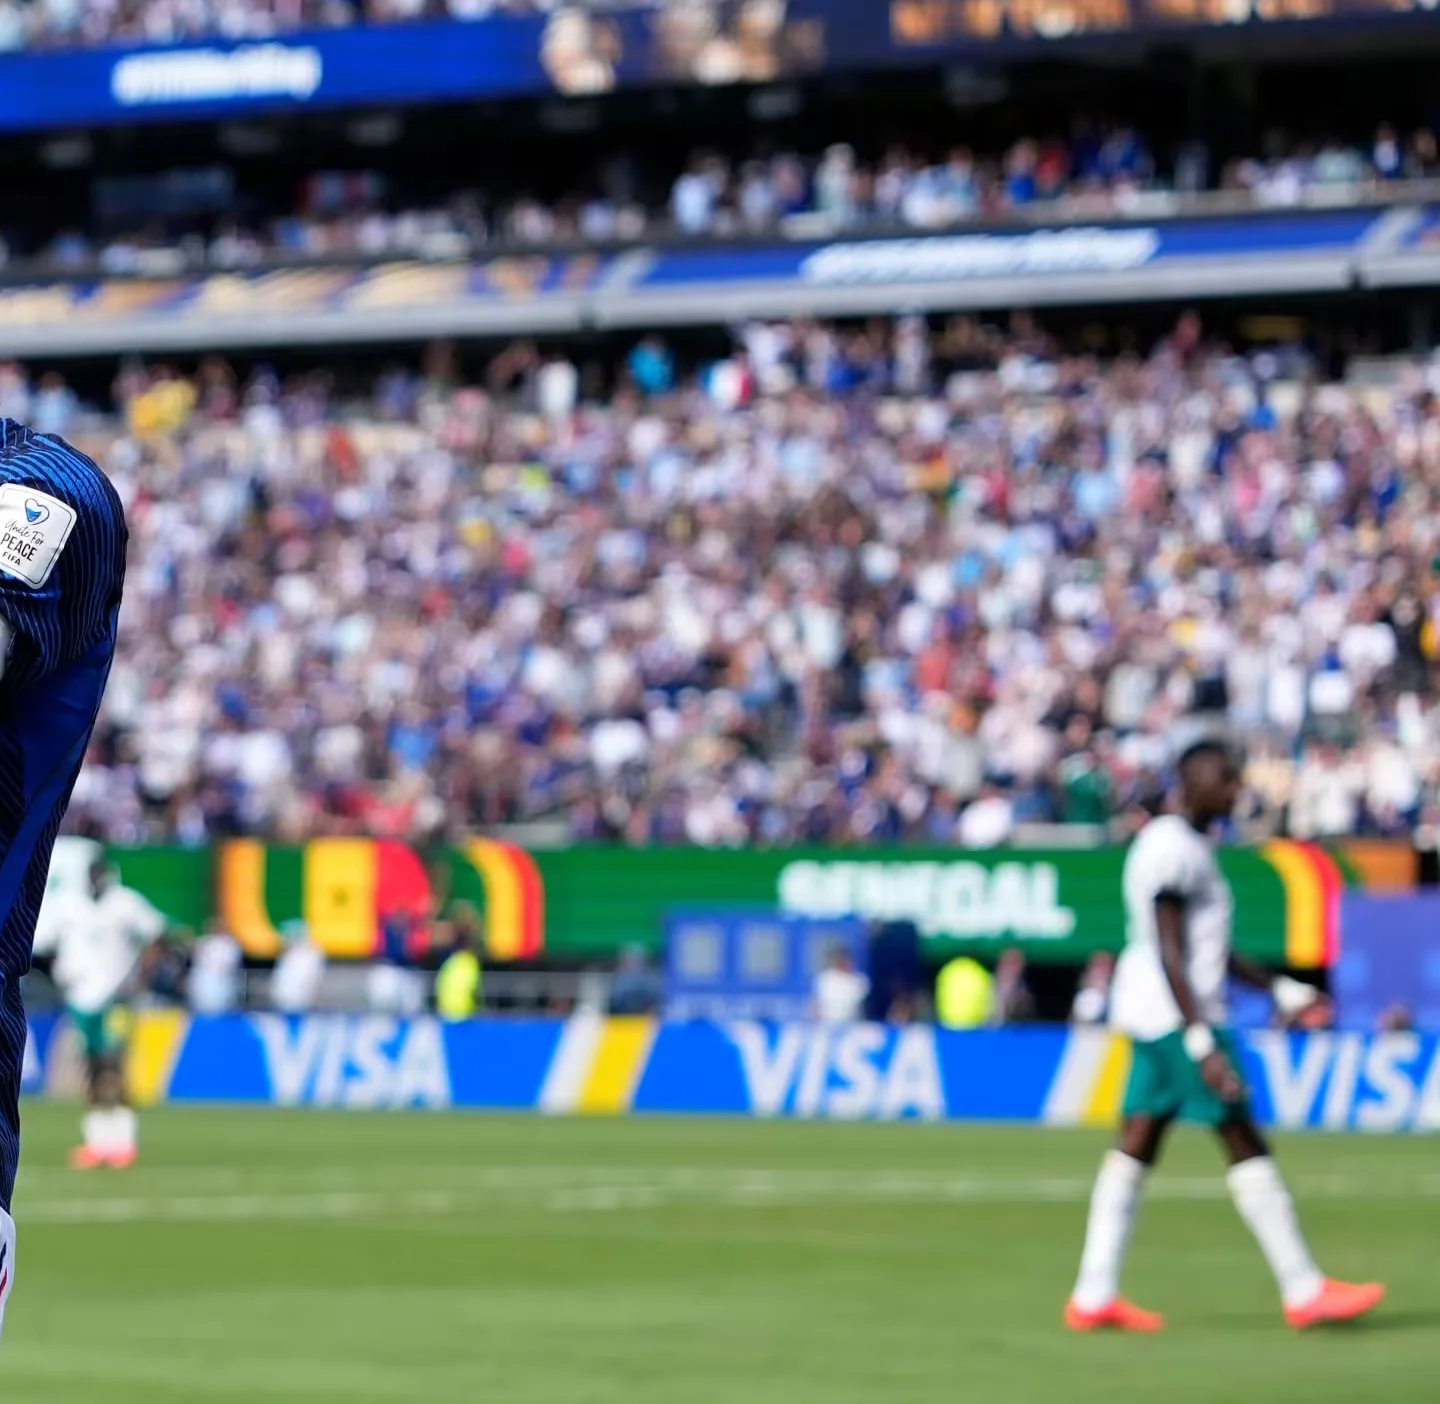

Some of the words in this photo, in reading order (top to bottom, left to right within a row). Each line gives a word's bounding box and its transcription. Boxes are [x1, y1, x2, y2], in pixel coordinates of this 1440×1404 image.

[0, 532, 38, 562] PEACE
[2, 551, 21, 566] FIFA
[4, 520, 30, 538] Unite
[31, 530, 44, 546] For
[777, 859, 1077, 938] SENEGAL
[248, 1010, 452, 1108] VISA
[728, 1020, 948, 1120] VISA
